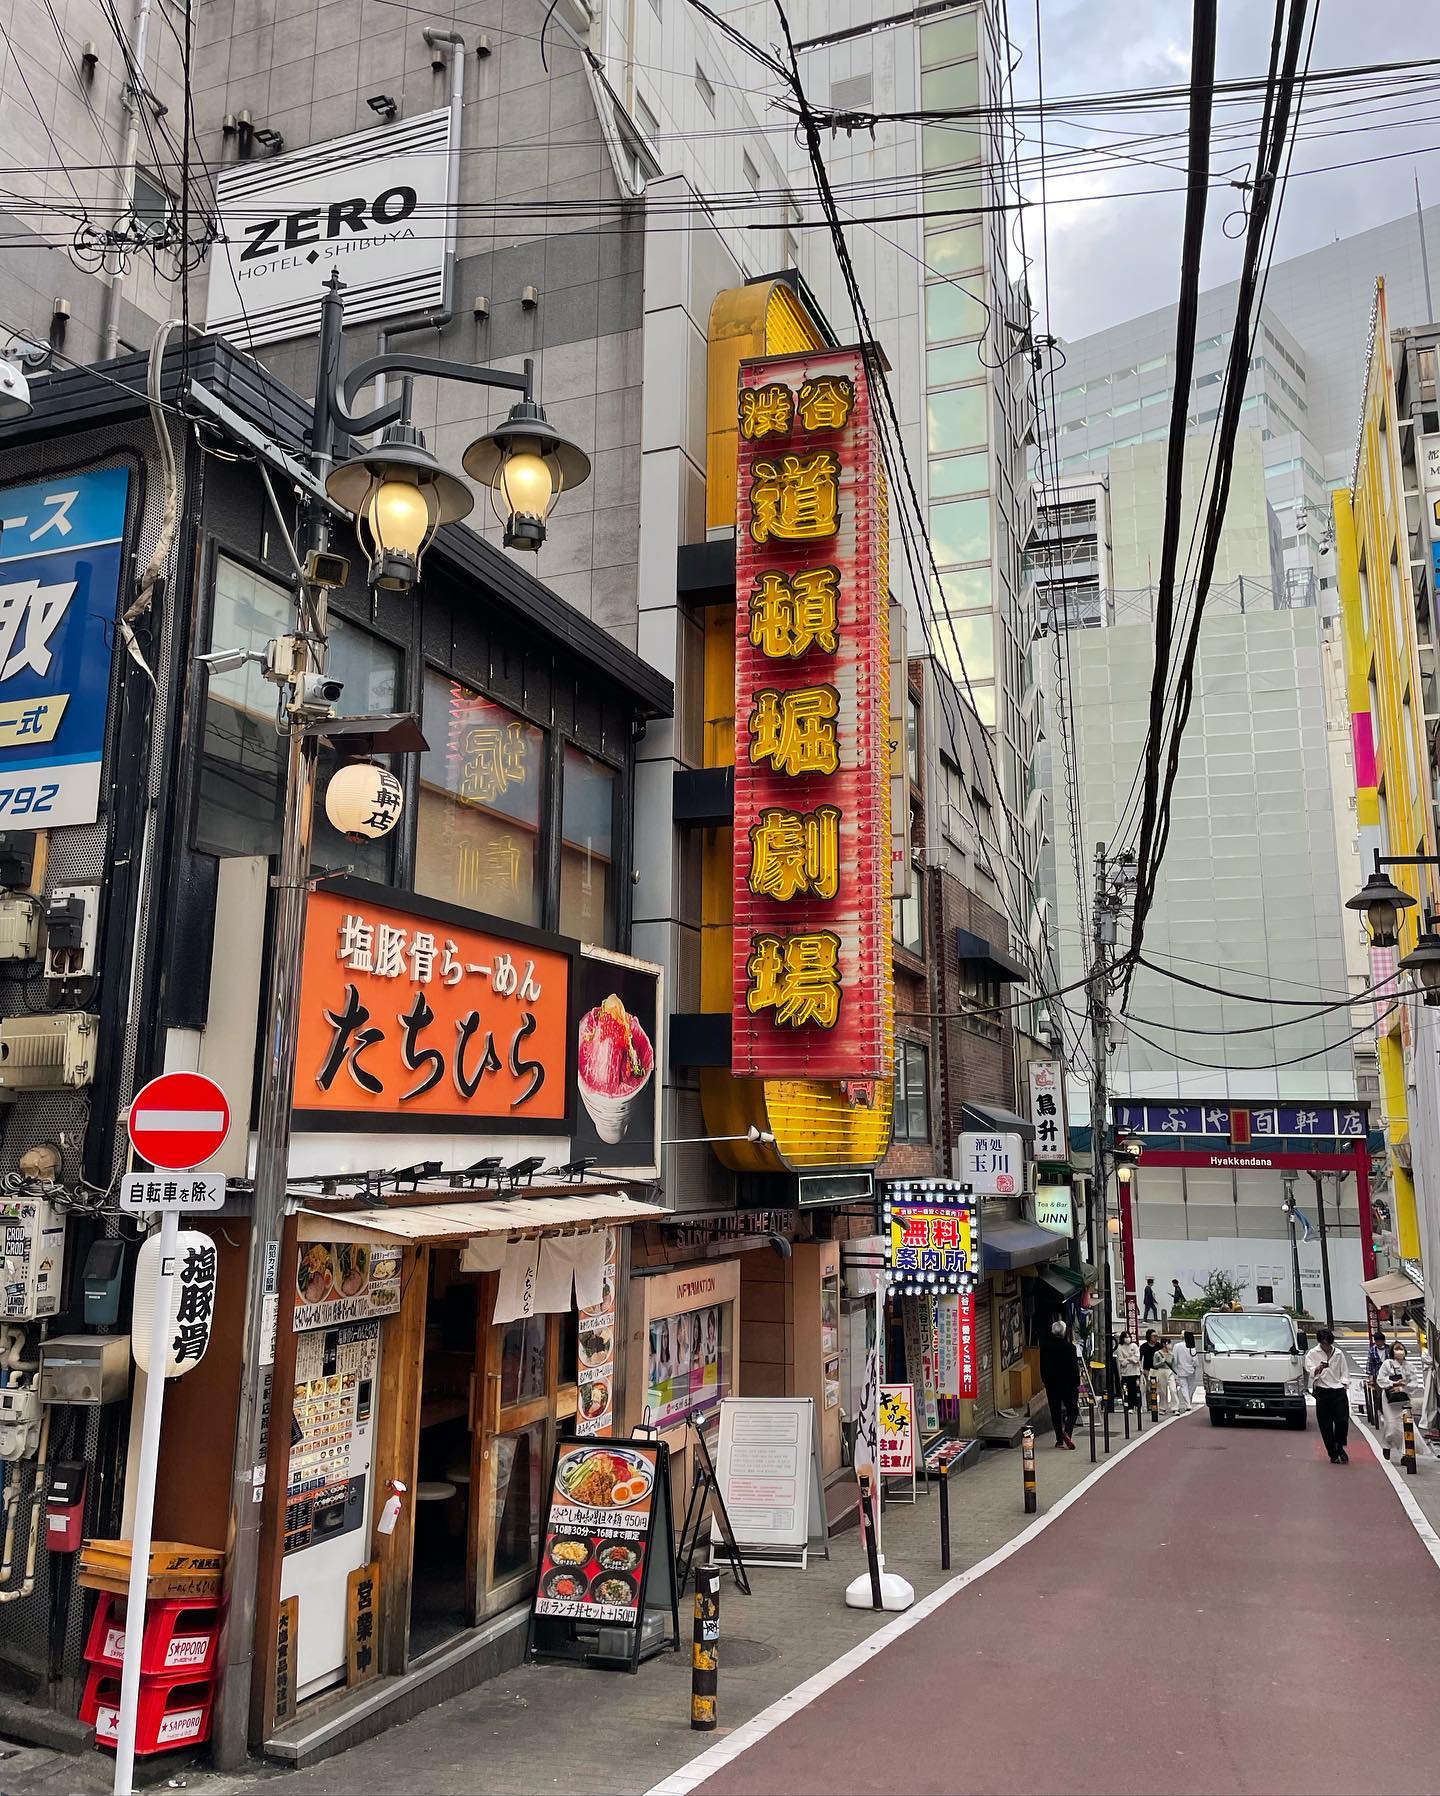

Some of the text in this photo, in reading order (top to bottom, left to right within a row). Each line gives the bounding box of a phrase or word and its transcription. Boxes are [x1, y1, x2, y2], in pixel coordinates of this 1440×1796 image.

[239, 186, 418, 262] ZERO
[238, 228, 415, 281] HOTEL SHIBUYA
[742, 380, 849, 437] 渋谷
[747, 453, 842, 1030] 道頓堀劇場
[336, 914, 543, 1003] 塩豚骨らーめん
[313, 983, 547, 1110] たちひら
[1121, 1106, 1363, 1136] しぶや 百軒店
[975, 1138, 1003, 1152] 酒処
[968, 1154, 1010, 1174] 玉川
[1210, 1156, 1272, 1167] Hyakkendana
[129, 1181, 217, 1204] 自転車を除く
[902, 1218, 960, 1249] 無料
[1038, 1213, 1068, 1224] JINN
[896, 1247, 967, 1273] 案内所
[172, 1246, 216, 1364] 塩豚骨
[524, 1266, 534, 1315] たちひら
[624, 1514, 649, 1528] 950円
[356, 1579, 374, 1673] 営業中
[168, 1717, 200, 1732] SAPPORO
